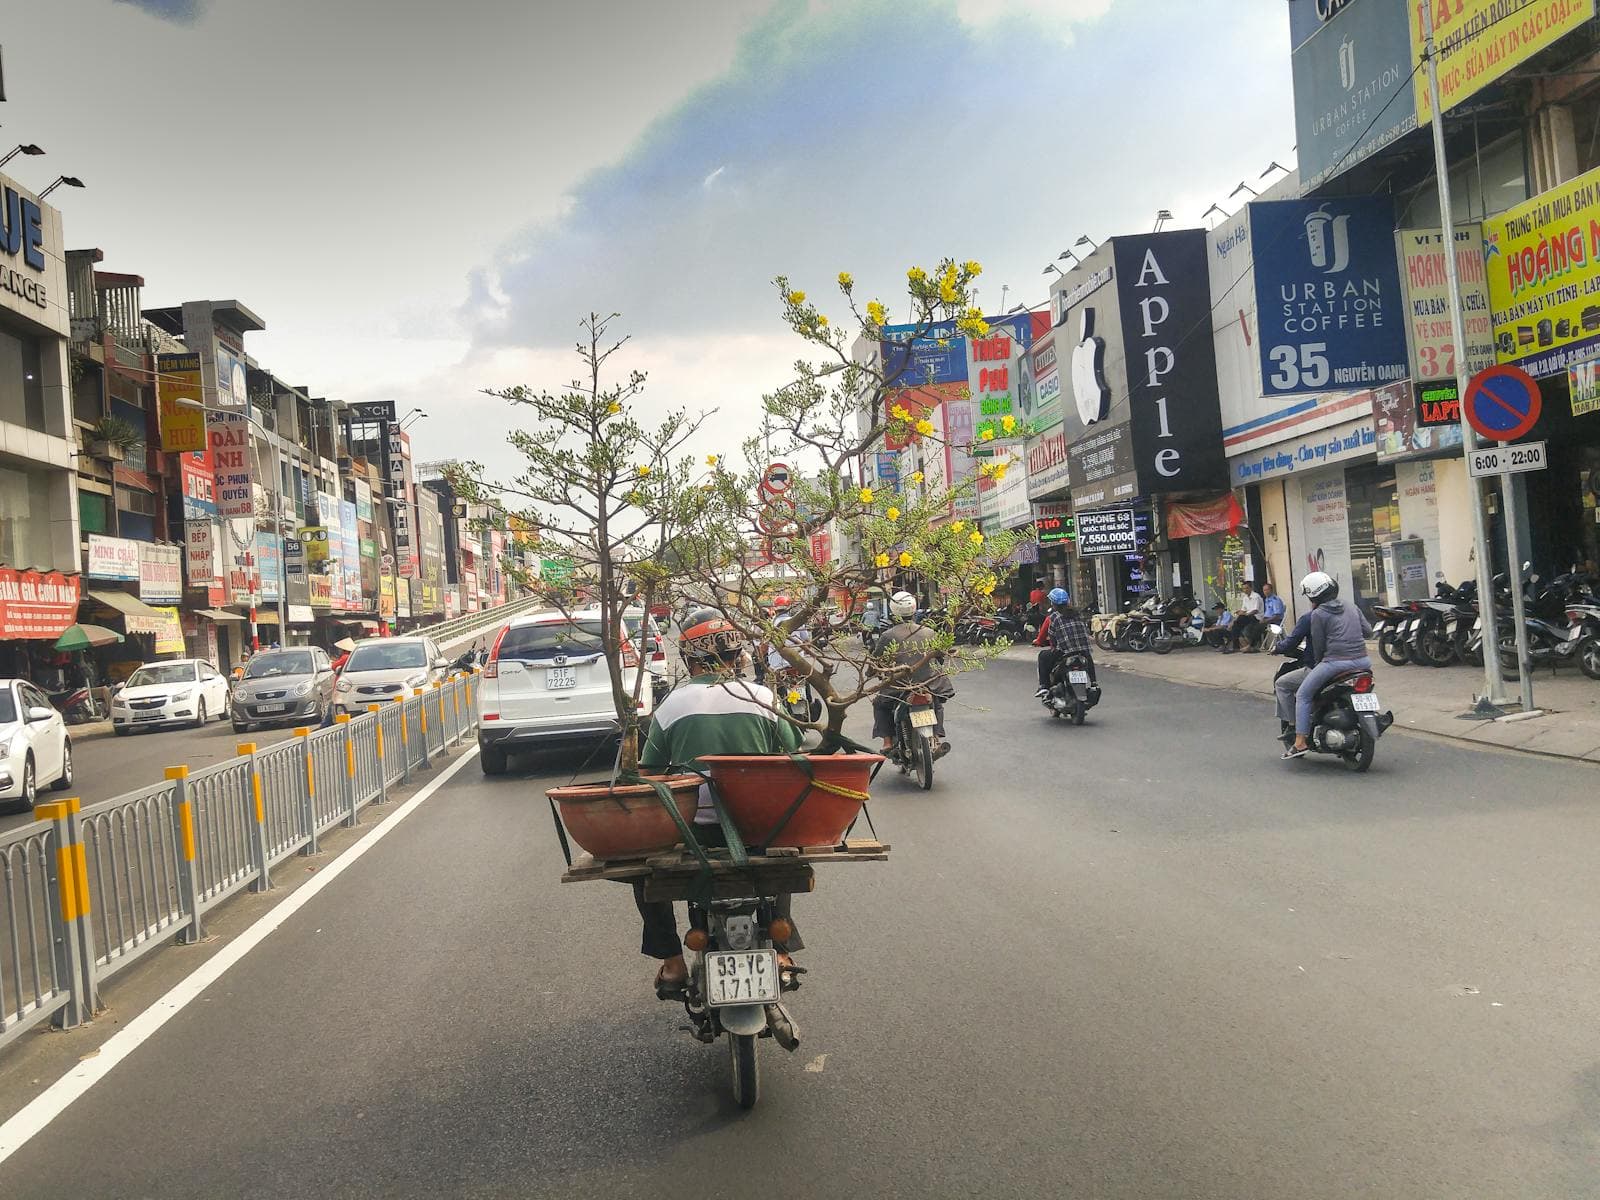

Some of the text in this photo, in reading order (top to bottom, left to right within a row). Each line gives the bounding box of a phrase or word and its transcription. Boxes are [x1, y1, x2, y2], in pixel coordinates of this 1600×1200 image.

[1508, 26, 1520, 53] IN
[1312, 102, 1347, 136] URBAN
[1352, 63, 1400, 110] STATION
[1336, 108, 1367, 138] COFFEE
[1505, 212, 1532, 241] TRUNG
[1553, 194, 1572, 221] MUA
[1574, 182, 1594, 212] BÁN
[1415, 235, 1429, 245] VI
[1507, 225, 1586, 297] HOÀNG
[1281, 278, 1380, 302] URBAN
[1283, 298, 1382, 317] STATION
[1413, 298, 1430, 316] MUA
[1509, 301, 1526, 321] BÁN
[1284, 312, 1383, 333] COFFEE
[1134, 248, 1181, 478] Apple
[1269, 342, 1406, 390] 35 NGUYỄN OANH
[1040, 375, 1059, 400] CASIO
[1298, 444, 1313, 462] Cho
[1314, 444, 1327, 461] vay
[1475, 455, 1498, 469] 6:00
[1511, 449, 1540, 465] 22:00
[240, 502, 252, 514] 68
[1080, 514, 1116, 525] IPHONE
[191, 529, 207, 543] BẾP
[94, 546, 114, 560] MINH
[190, 548, 211, 562] NHẬP
[21, 577, 37, 602] GIÁ
[548, 677, 576, 688] 72225
